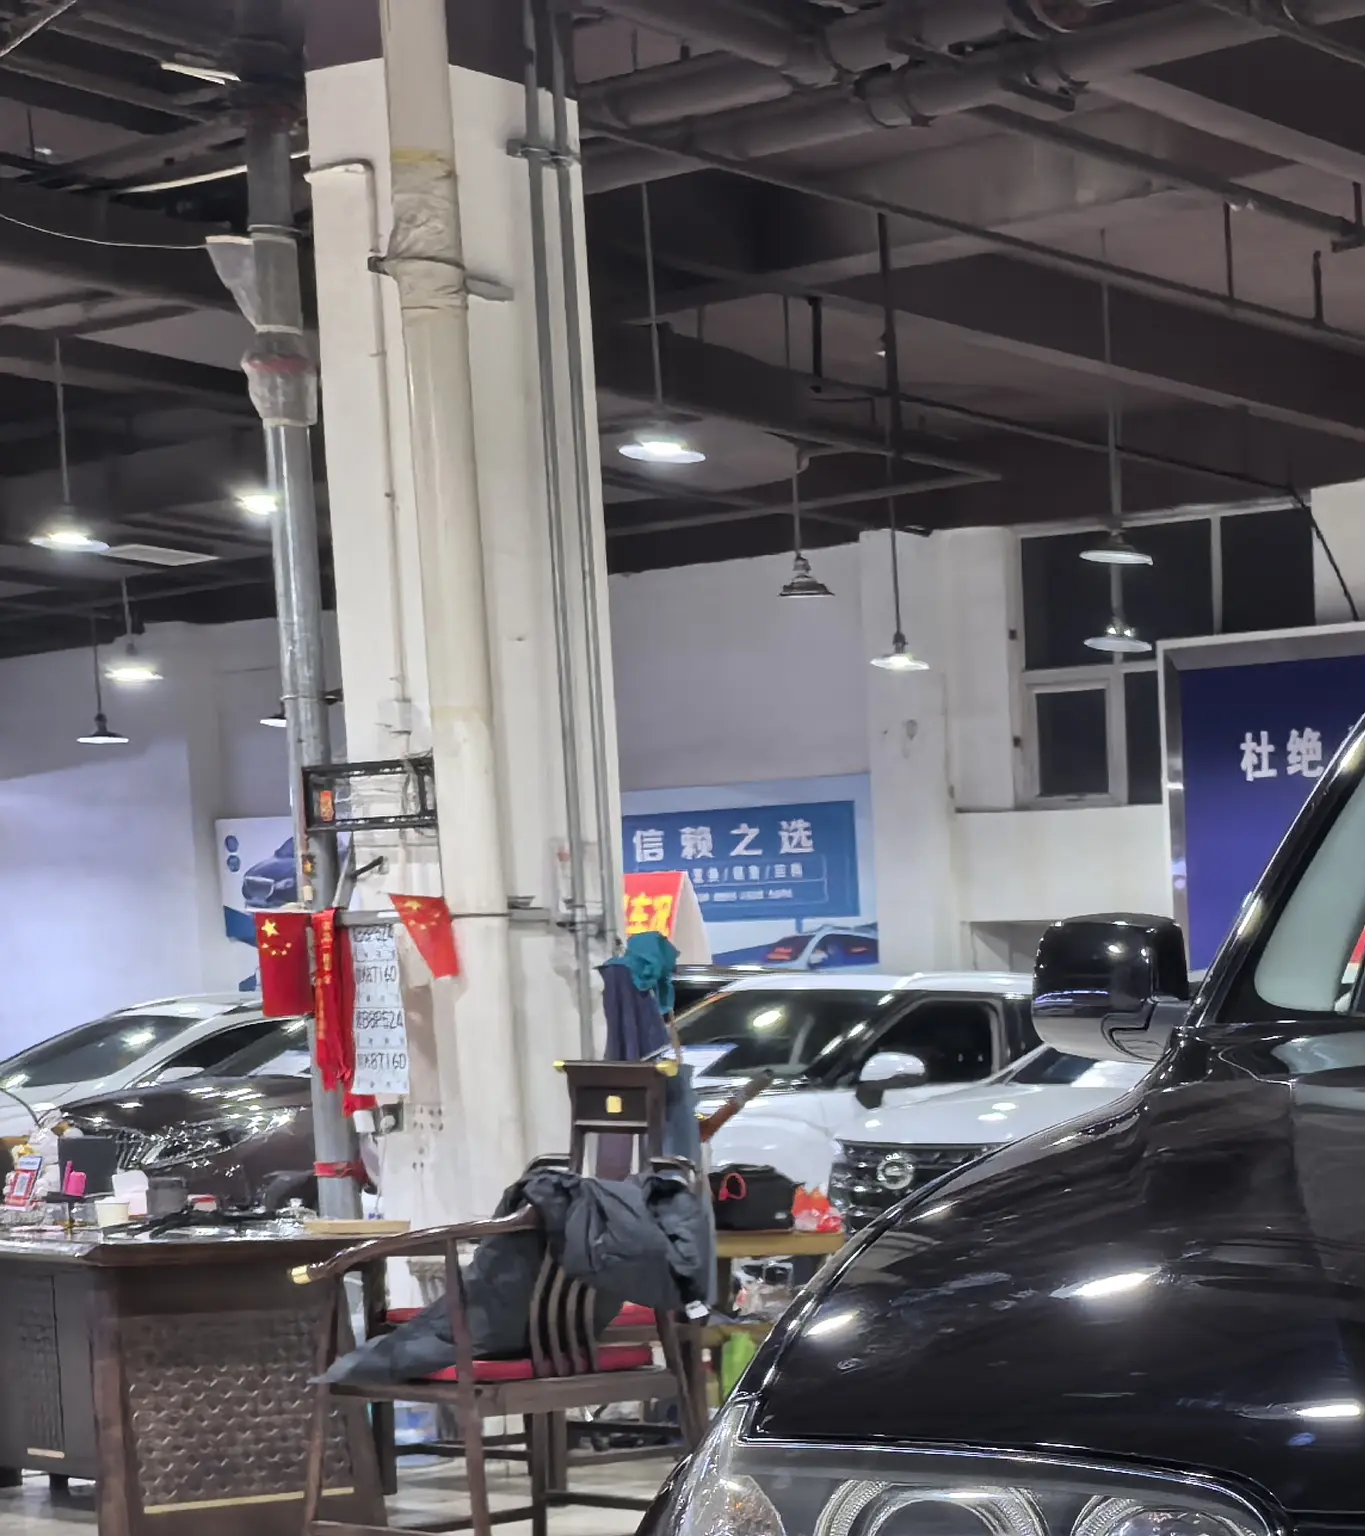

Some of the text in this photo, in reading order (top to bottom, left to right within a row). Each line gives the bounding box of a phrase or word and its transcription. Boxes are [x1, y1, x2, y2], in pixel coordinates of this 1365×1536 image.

[1240, 727, 1324, 782] 杜绝
[633, 818, 815, 862] 信赖之选
